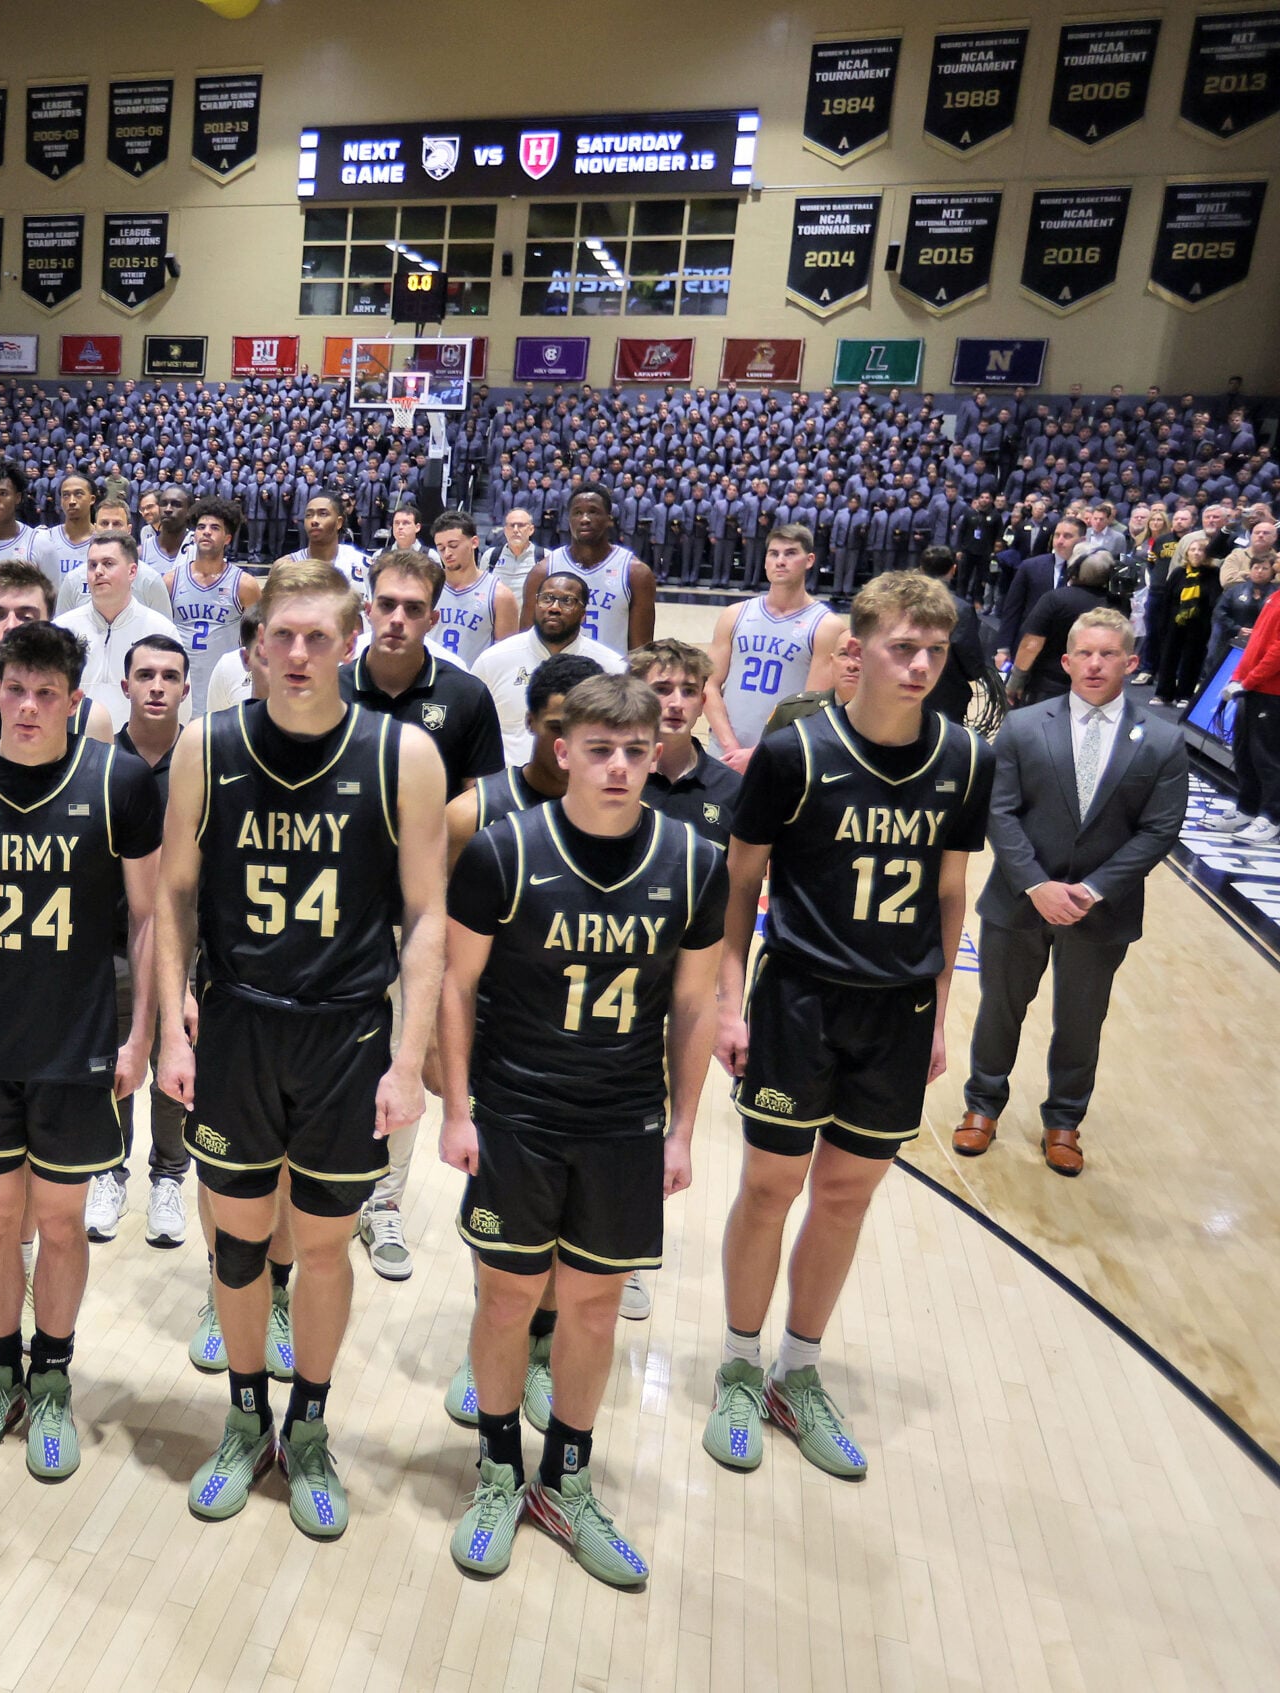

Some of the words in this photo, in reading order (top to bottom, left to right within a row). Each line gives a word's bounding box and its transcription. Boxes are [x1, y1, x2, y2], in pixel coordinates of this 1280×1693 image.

[1231, 32, 1256, 44] NIT
[851, 46, 893, 56] BASKETBALL
[960, 51, 994, 62] NCAA
[1088, 42, 1124, 54] NCAA
[837, 59, 868, 70] NCAA
[937, 60, 1018, 74] TOURNAMENT
[1063, 52, 1148, 66] TOURNAMENT
[815, 68, 891, 82] TOURNAMENT
[1203, 73, 1268, 94] 2013
[942, 89, 1001, 109] 1988
[1067, 82, 1132, 102] 2006
[32, 108, 82, 119] CHAMPIONS
[42, 100, 72, 110] LEAGUE
[114, 104, 166, 115] CHAMPIONS
[200, 100, 254, 111] CHAMPIONS
[822, 96, 876, 116] 1984
[115, 126, 163, 138] 2005-06
[204, 121, 249, 134] 2012-13
[343, 141, 401, 162] NEXT
[526, 137, 551, 166] H
[576, 134, 683, 154] SATURDAY
[473, 147, 504, 167] VS
[574, 154, 687, 174] NOVEMBER
[690, 152, 716, 171] 15
[341, 164, 405, 185] GAME
[800, 204, 832, 212] WOMEN'S
[1076, 195, 1122, 204] BASKETBALL
[1195, 202, 1228, 214] WNIT
[819, 214, 850, 225] NCAA
[942, 208, 964, 219] NIT
[1063, 209, 1093, 218] NCAA
[120, 228, 152, 237] LEAGUE
[797, 224, 872, 236] TOURNAMENT
[1040, 218, 1115, 230] TOURNAMENT
[28, 239, 76, 248] CHAMPIONS
[109, 237, 160, 246] CHAMPIONS
[804, 250, 855, 268] 2014
[918, 248, 974, 265] 2015
[1042, 247, 1101, 266] 2016
[1172, 242, 1237, 260] 2025
[28, 258, 75, 270] 2015-16
[109, 256, 158, 268] 2015-16
[407, 273, 432, 292] 0.0
[353, 305, 376, 313] ARMY
[252, 340, 279, 360] BU
[865, 346, 888, 371] L
[986, 350, 1014, 372] N
[177, 603, 229, 624] DUKE
[440, 608, 484, 631] UKE
[192, 621, 209, 650] 2
[737, 634, 802, 662] DUKE
[740, 656, 783, 695] 20
[237, 810, 350, 853] ARMY
[834, 806, 945, 846] ARMY
[852, 856, 922, 924] 12
[246, 864, 340, 938] 54
[544, 912, 666, 955] ARMY
[562, 964, 640, 1034] 14
